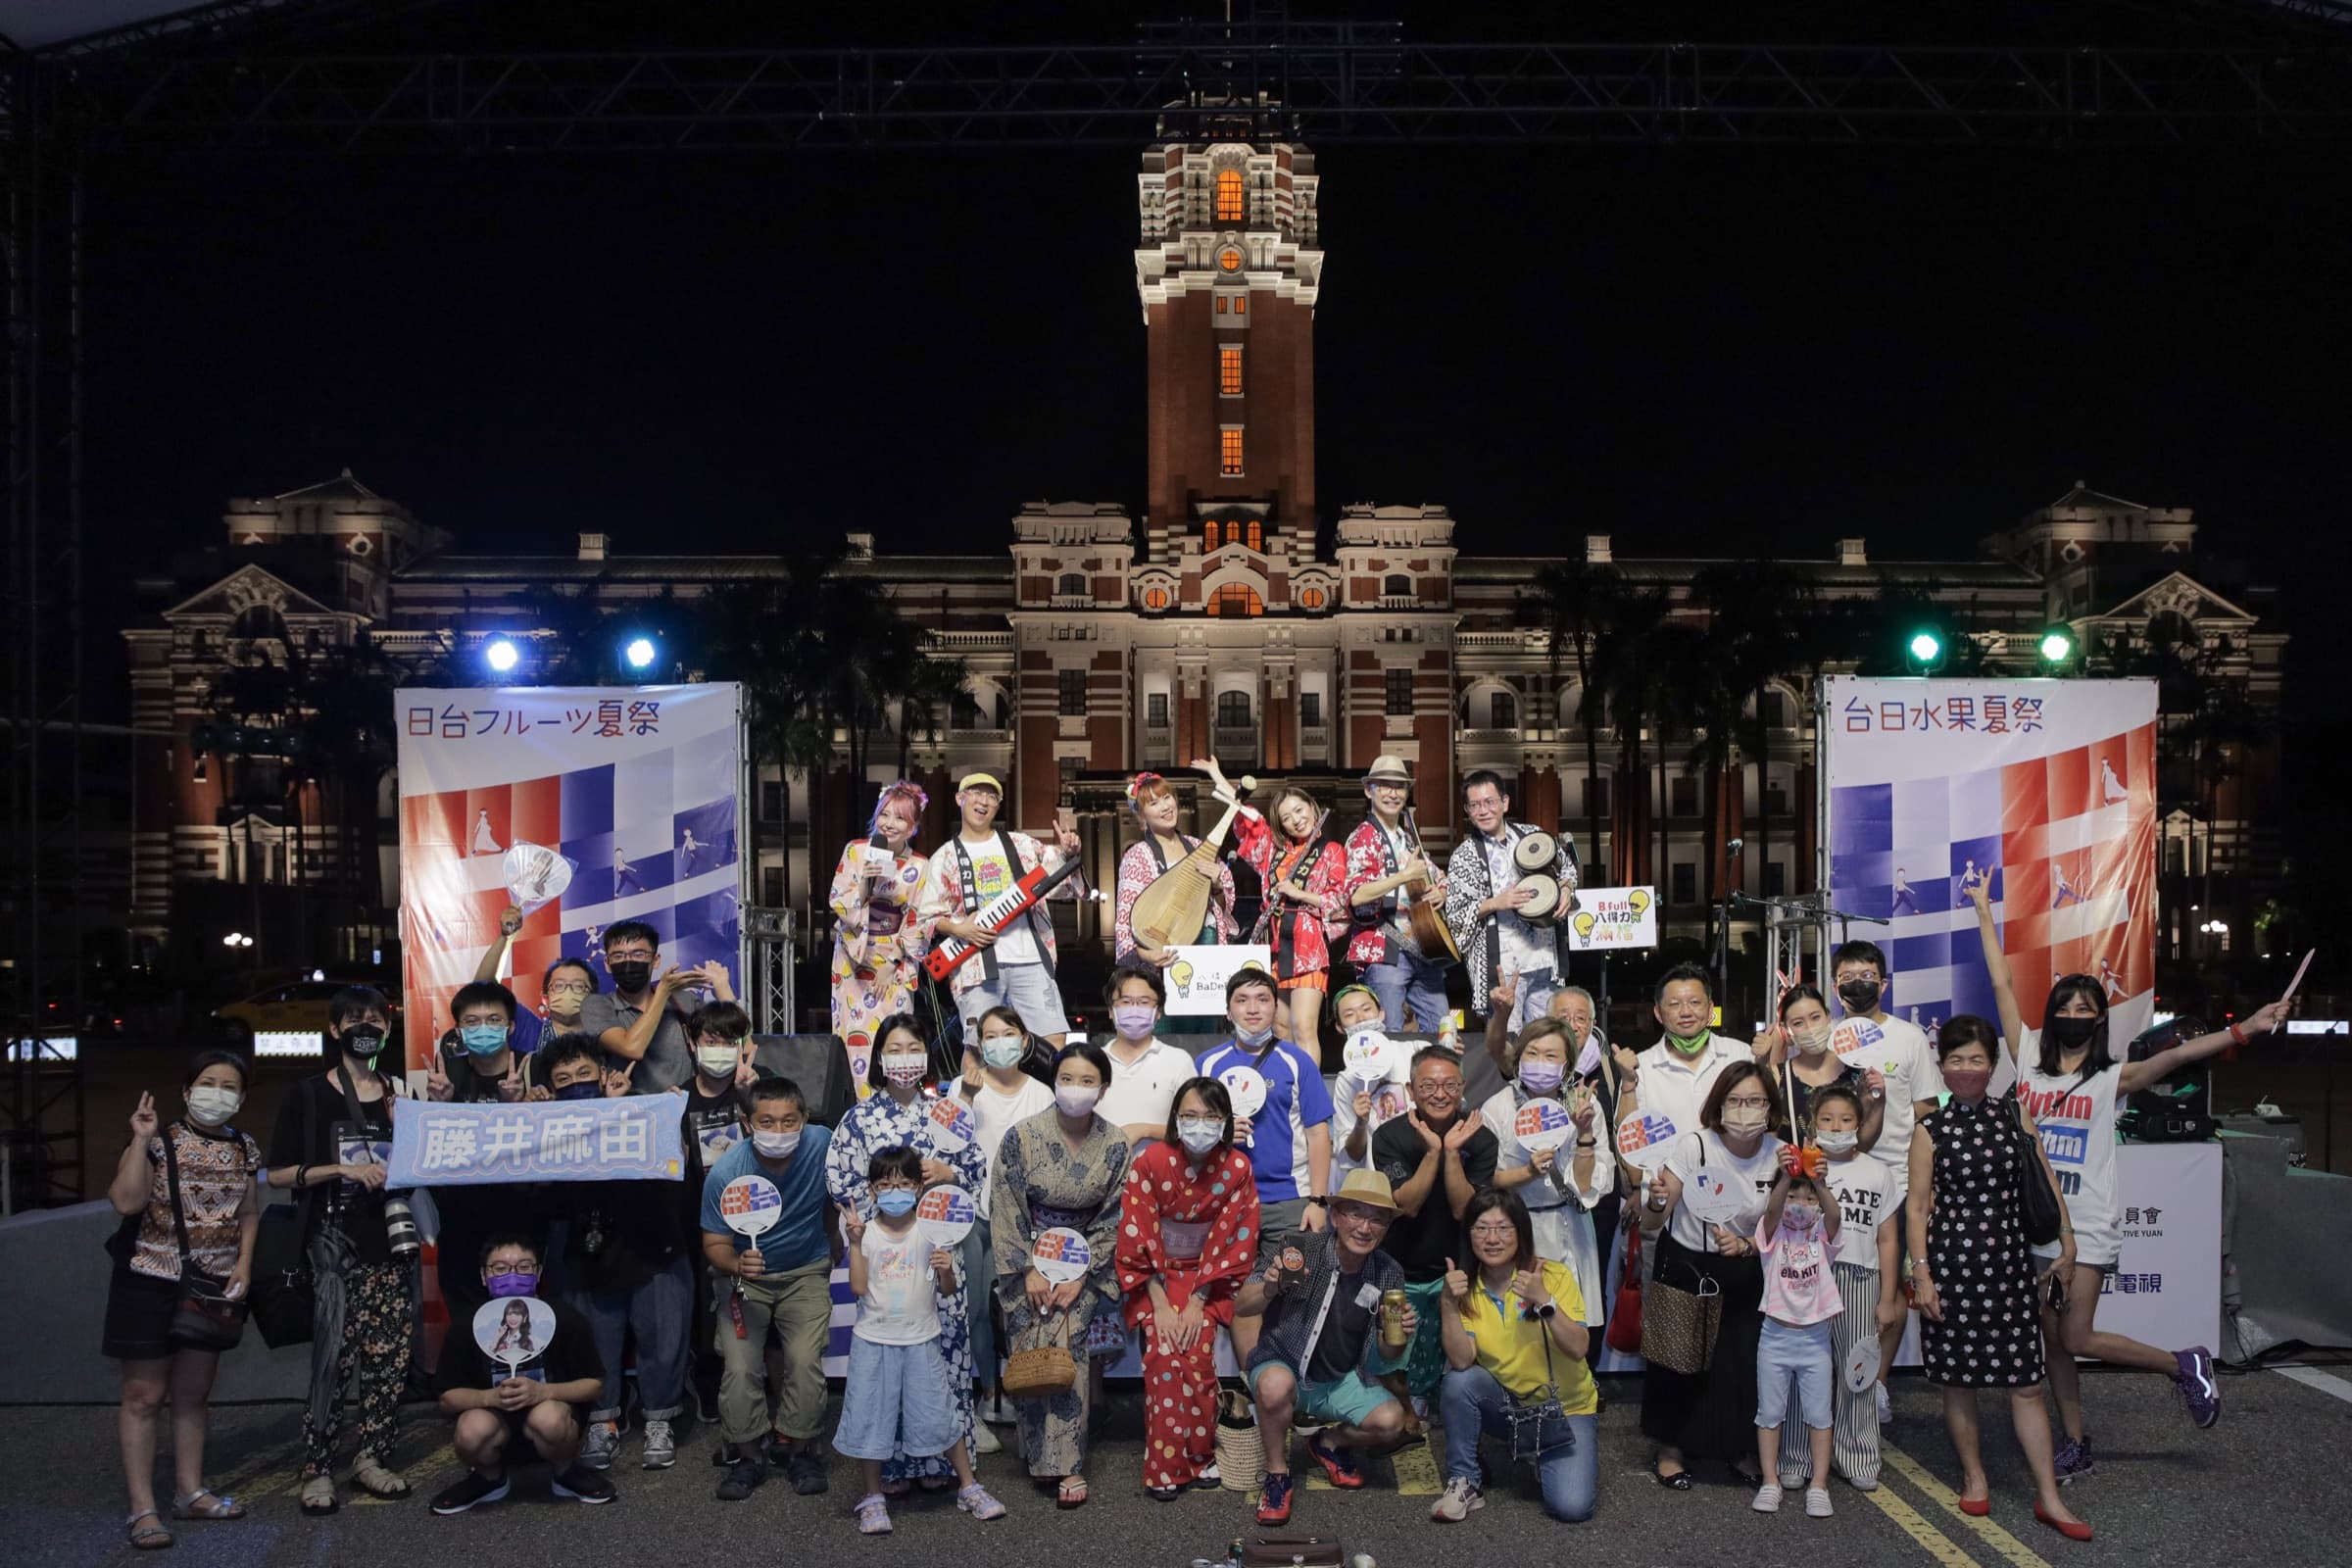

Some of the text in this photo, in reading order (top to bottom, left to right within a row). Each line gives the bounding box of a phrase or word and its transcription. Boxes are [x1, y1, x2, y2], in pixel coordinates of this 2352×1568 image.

[409, 699, 660, 738] 日台フルーツ夏祭
[1844, 695, 2042, 734] 台日水果夏祭
[1594, 911, 1631, 924] 八得力
[422, 1110, 648, 1169] 藤井麻由
